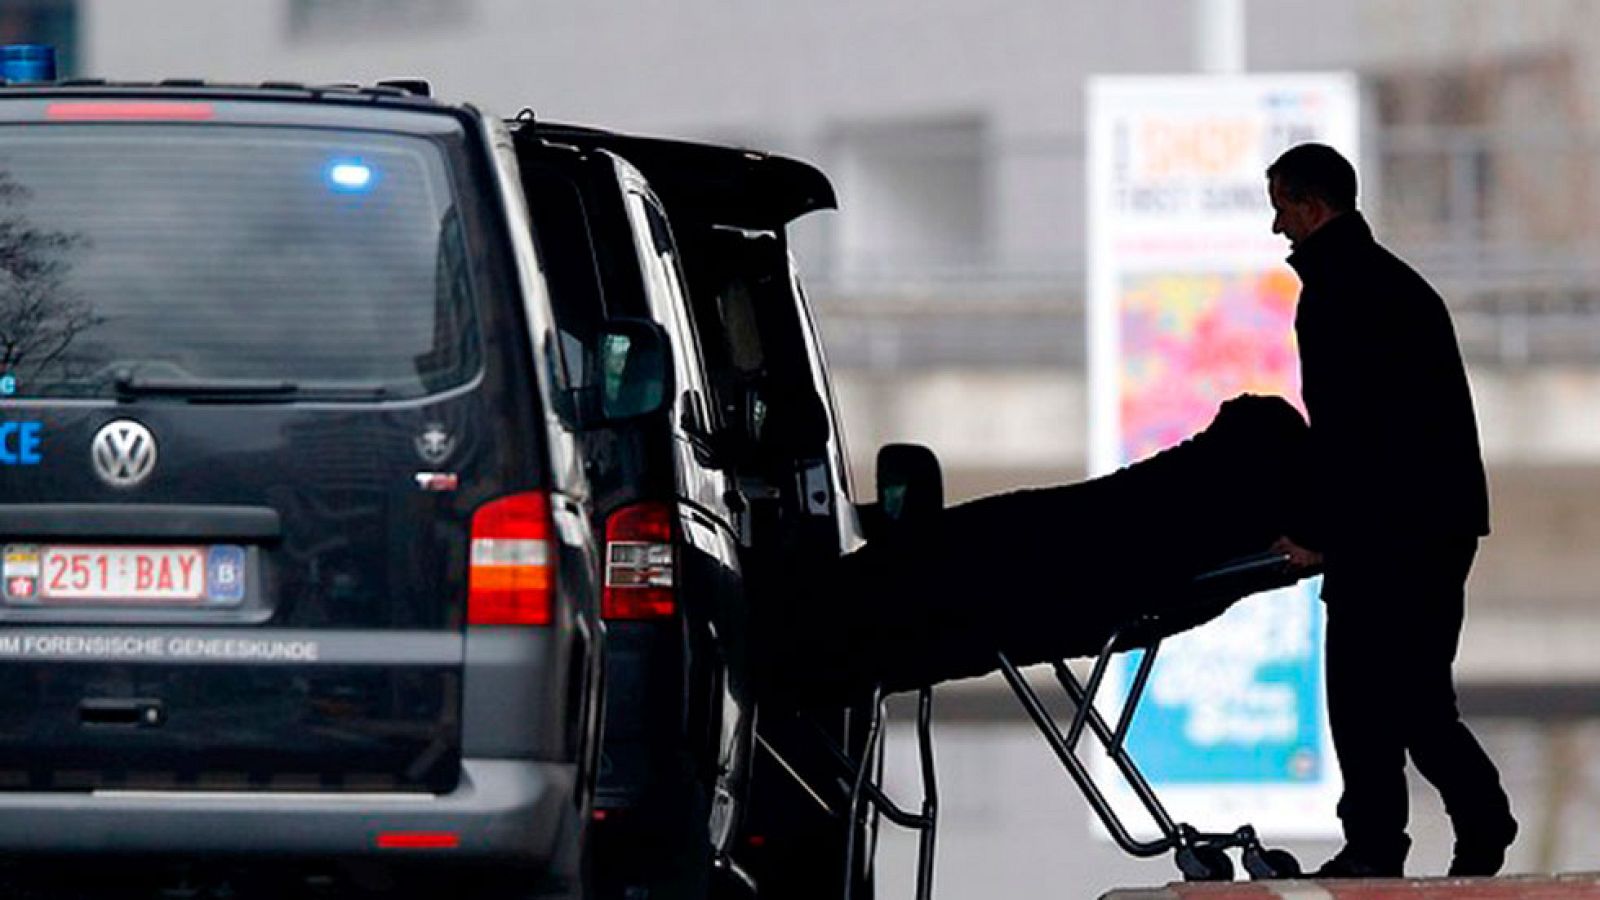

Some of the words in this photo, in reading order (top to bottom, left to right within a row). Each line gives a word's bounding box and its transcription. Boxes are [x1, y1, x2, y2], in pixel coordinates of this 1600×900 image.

[218, 563, 235, 583] B
[25, 636, 163, 655] FORENSISCHE
[168, 638, 319, 661] GENEESKUNDE
